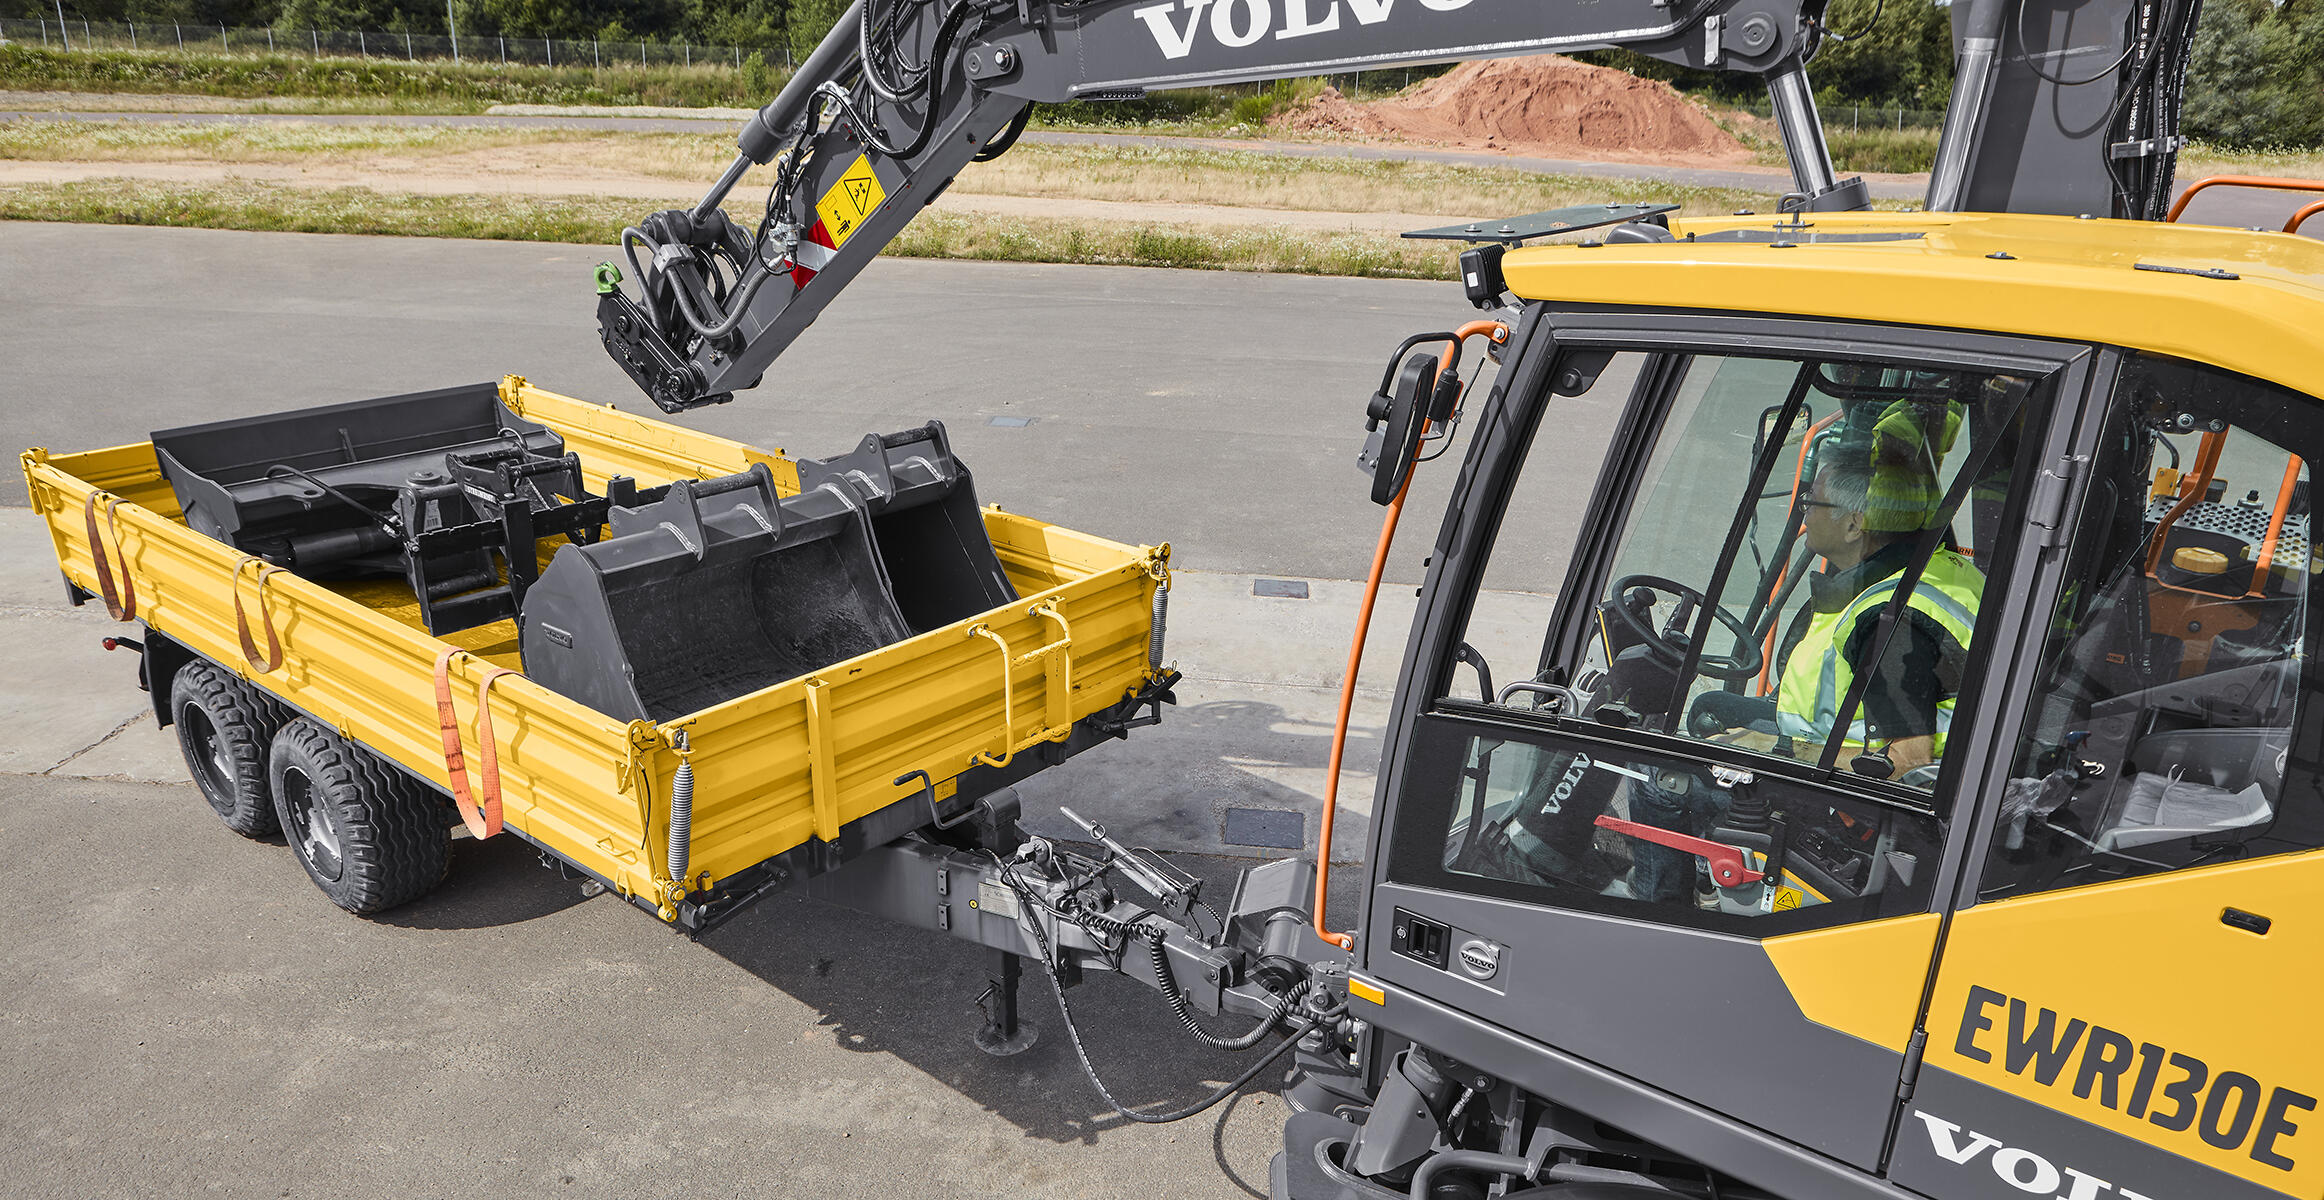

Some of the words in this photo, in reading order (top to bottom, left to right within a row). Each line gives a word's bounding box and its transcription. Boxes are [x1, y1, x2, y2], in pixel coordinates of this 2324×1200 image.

[1134, 0, 1475, 60] VOLV
[1461, 952, 1495, 969] VOLVO
[1954, 985, 2317, 1171] EWR130E
[1914, 1110, 2154, 1200] VOL
